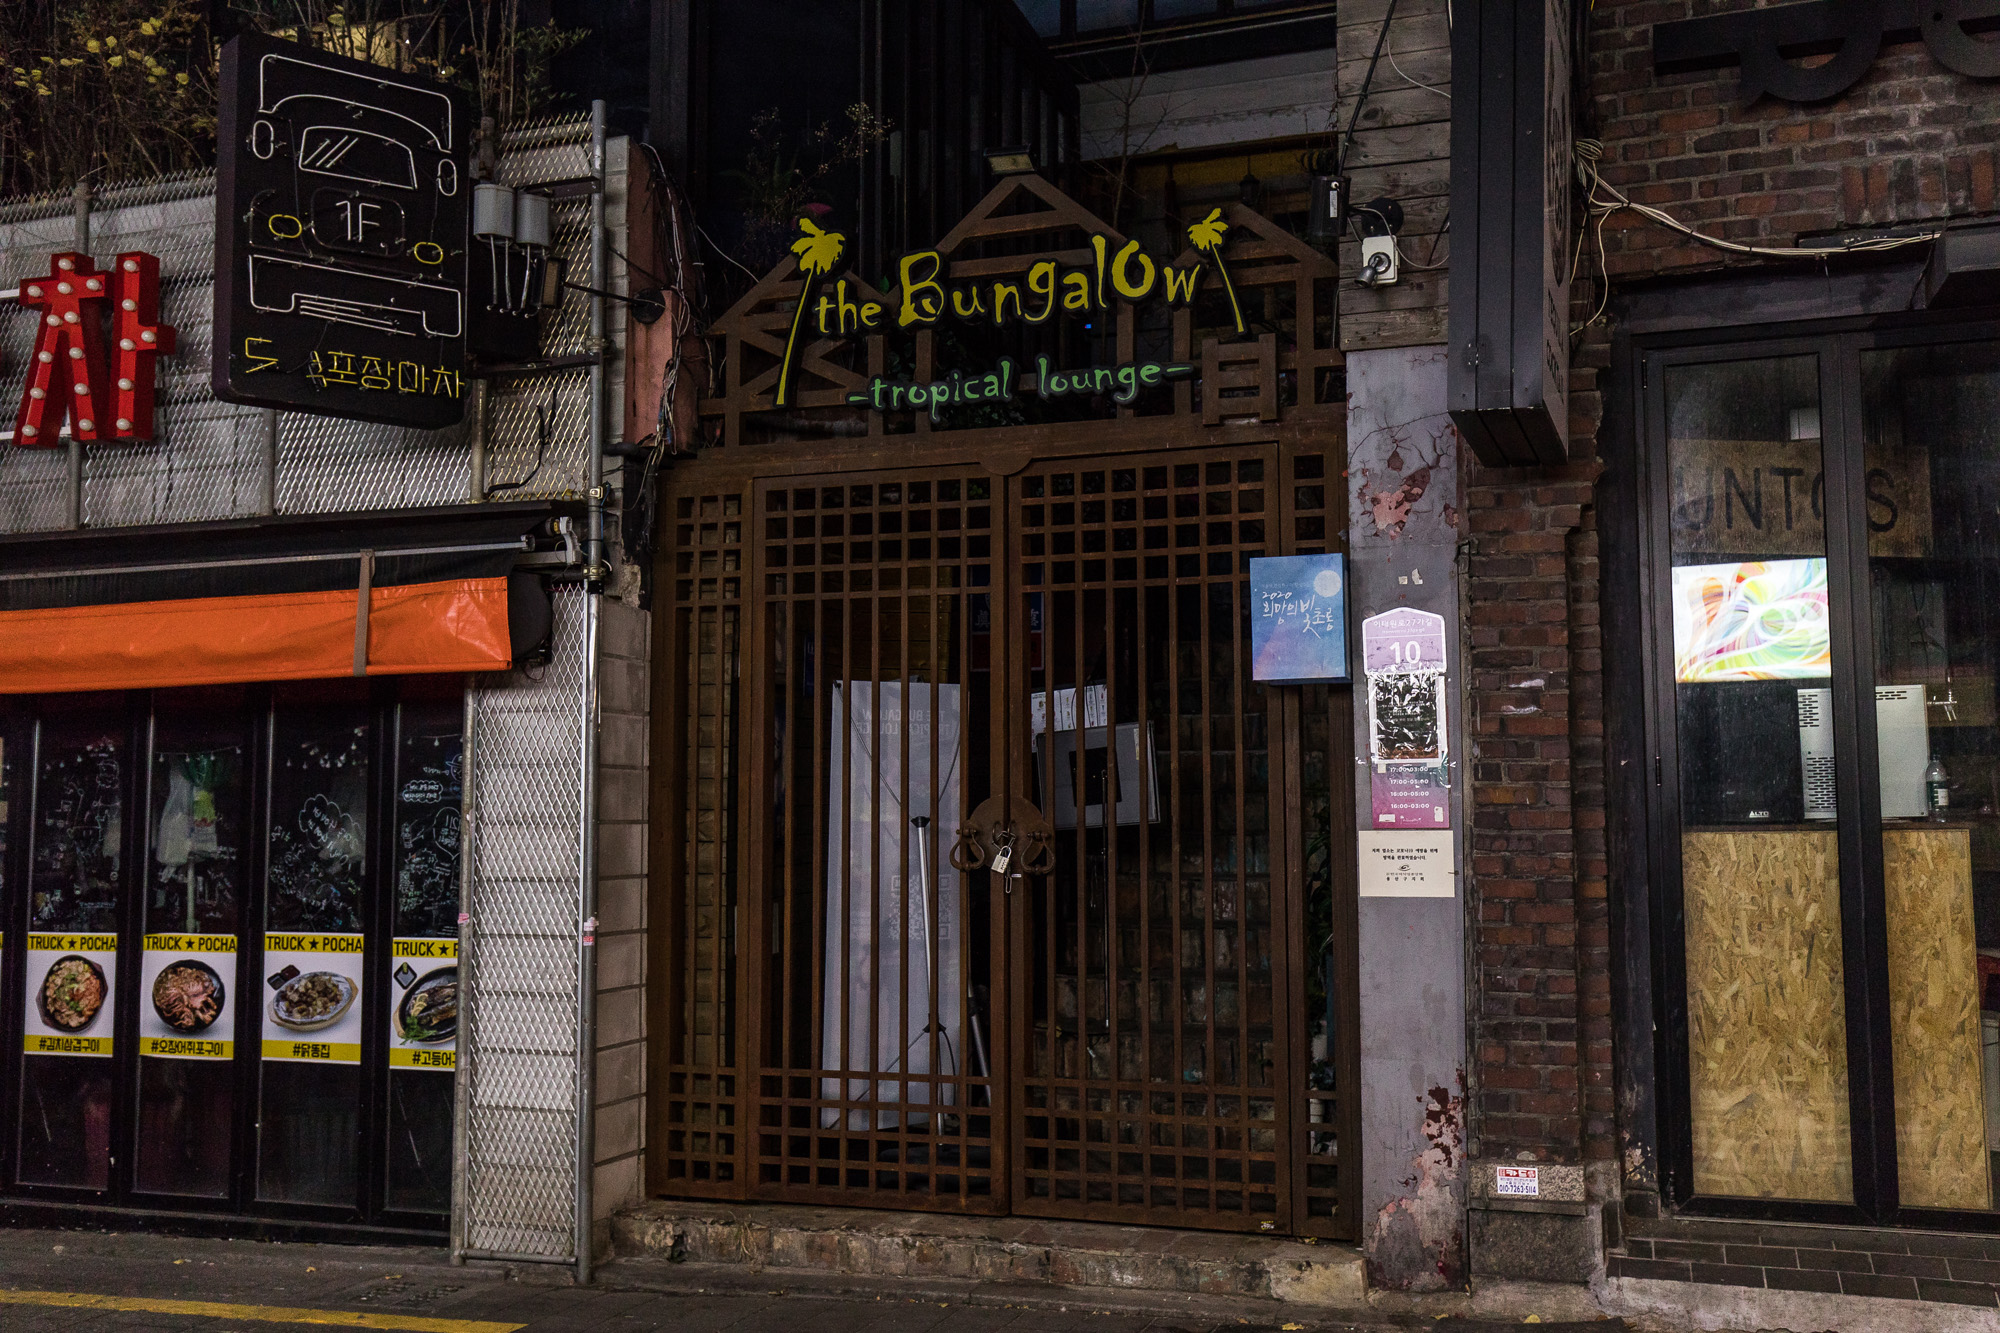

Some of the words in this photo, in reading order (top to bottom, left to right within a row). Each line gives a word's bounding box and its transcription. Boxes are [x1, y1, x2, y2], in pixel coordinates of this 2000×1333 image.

[335, 199, 382, 243] 1F
[814, 279, 883, 336] the
[1262, 591, 1293, 600] 2020
[1262, 599, 1299, 625] 희망의
[1389, 640, 1422, 665] 10
[30, 935, 64, 951] TRUCK
[80, 936, 118, 952] POCHA
[145, 935, 183, 952] TRUCK
[197, 936, 237, 953] POCHA
[267, 935, 306, 951] TRUCK
[322, 937, 364, 953] POCHA
[394, 941, 436, 957] TRUCK
[411, 1051, 456, 1066] #고등어
